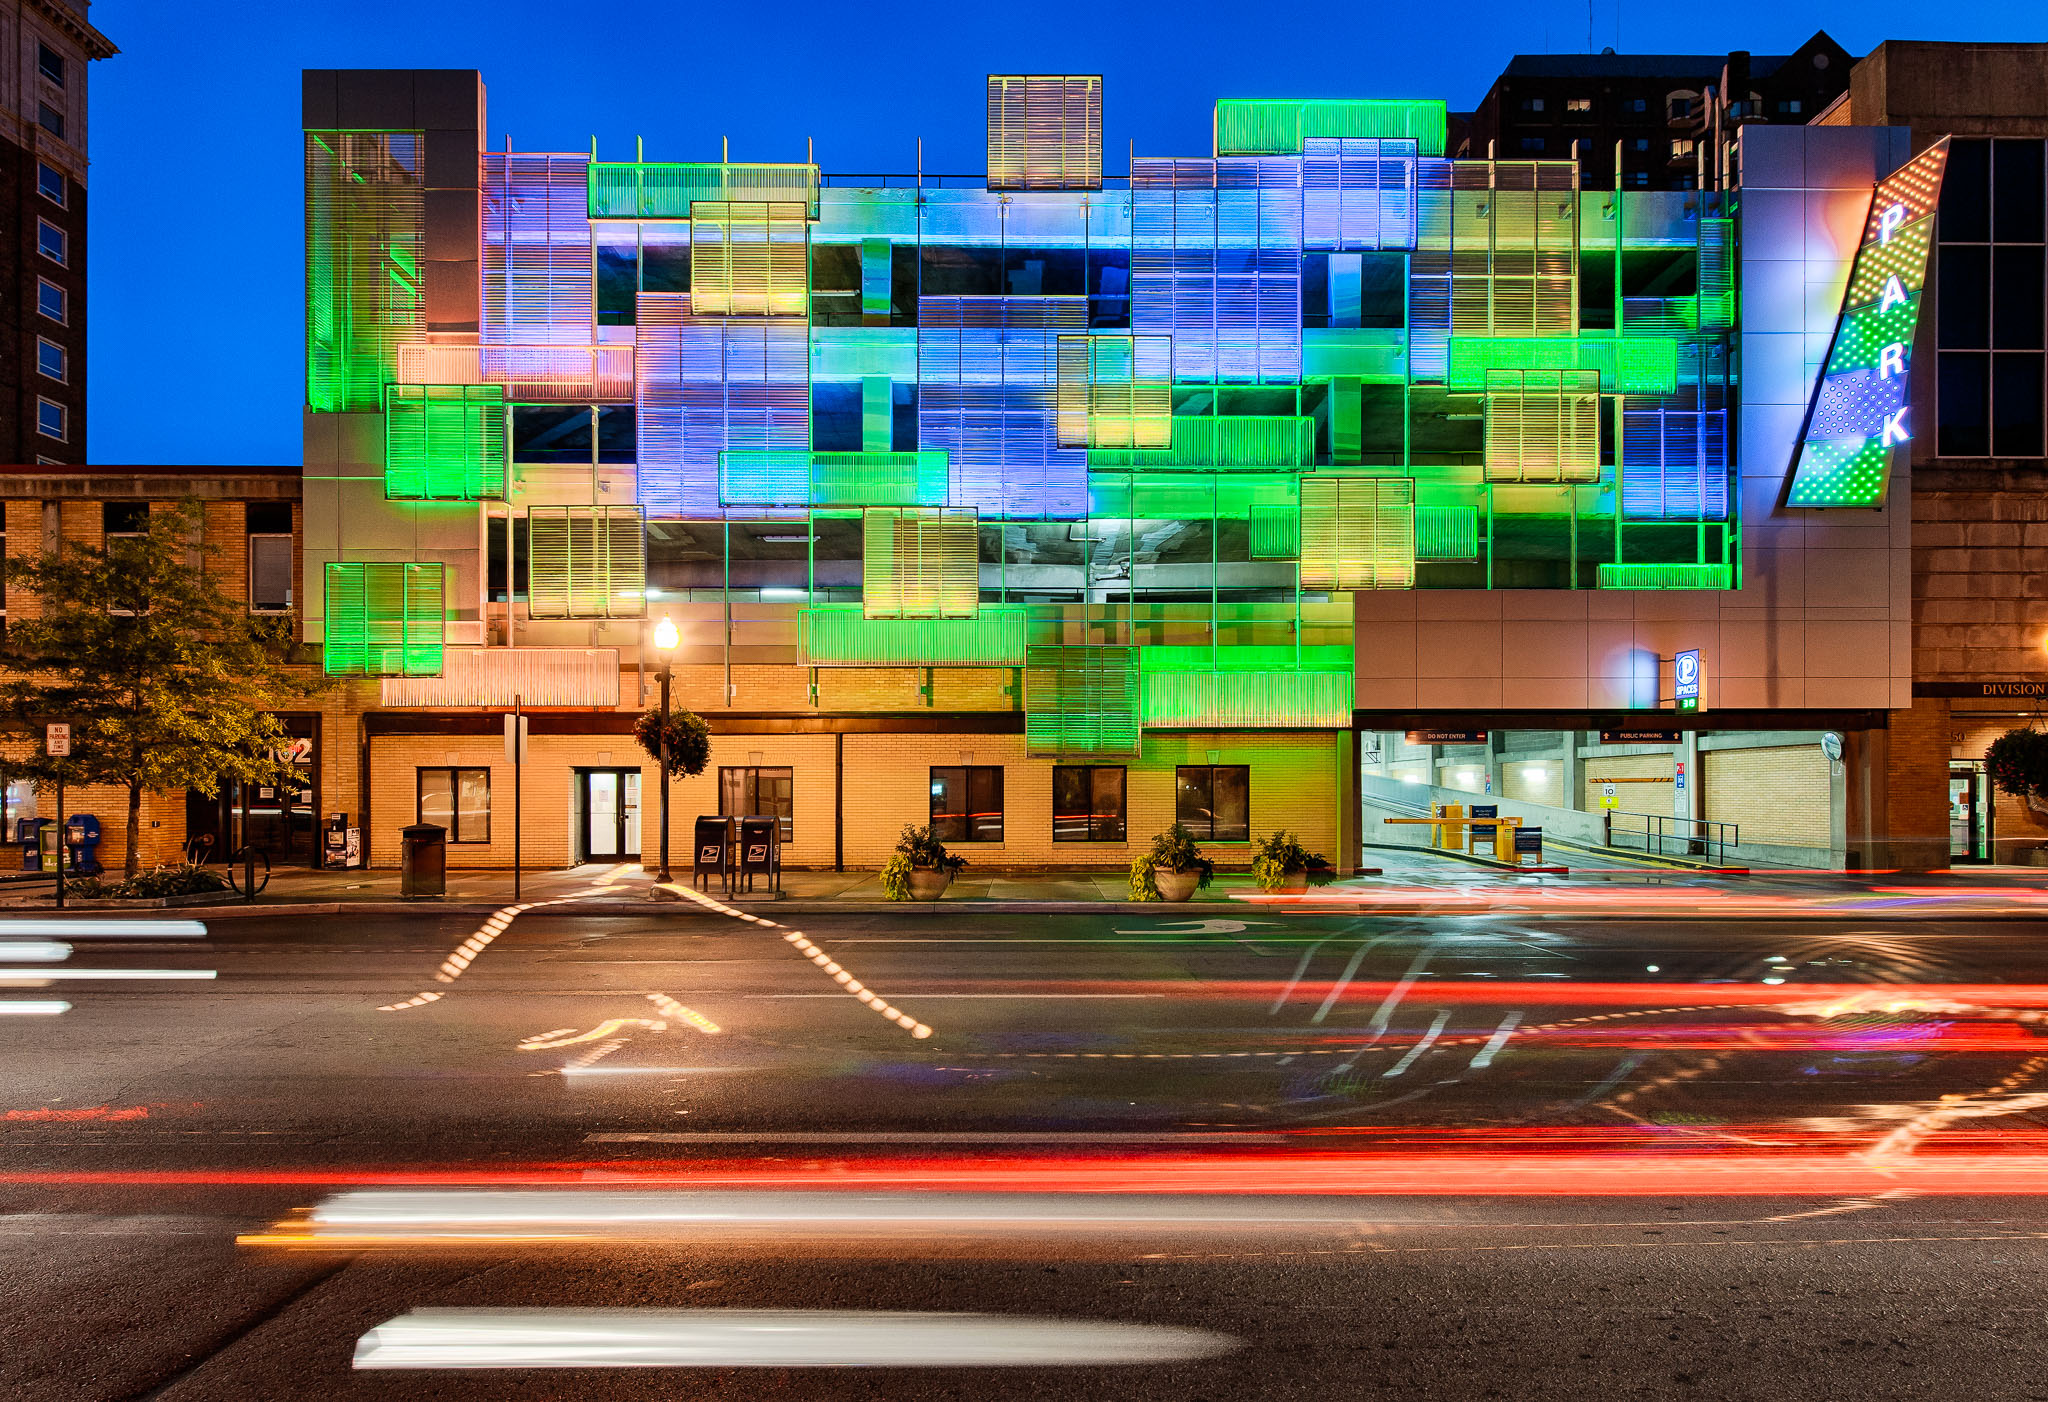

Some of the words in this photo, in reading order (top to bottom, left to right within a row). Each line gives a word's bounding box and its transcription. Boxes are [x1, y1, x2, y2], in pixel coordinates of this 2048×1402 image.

[1880, 203, 1910, 448] PARK
[1677, 684, 1697, 696] SPACES
[1983, 684, 2045, 695] DIVISION
[1951, 732, 1966, 742] 50
